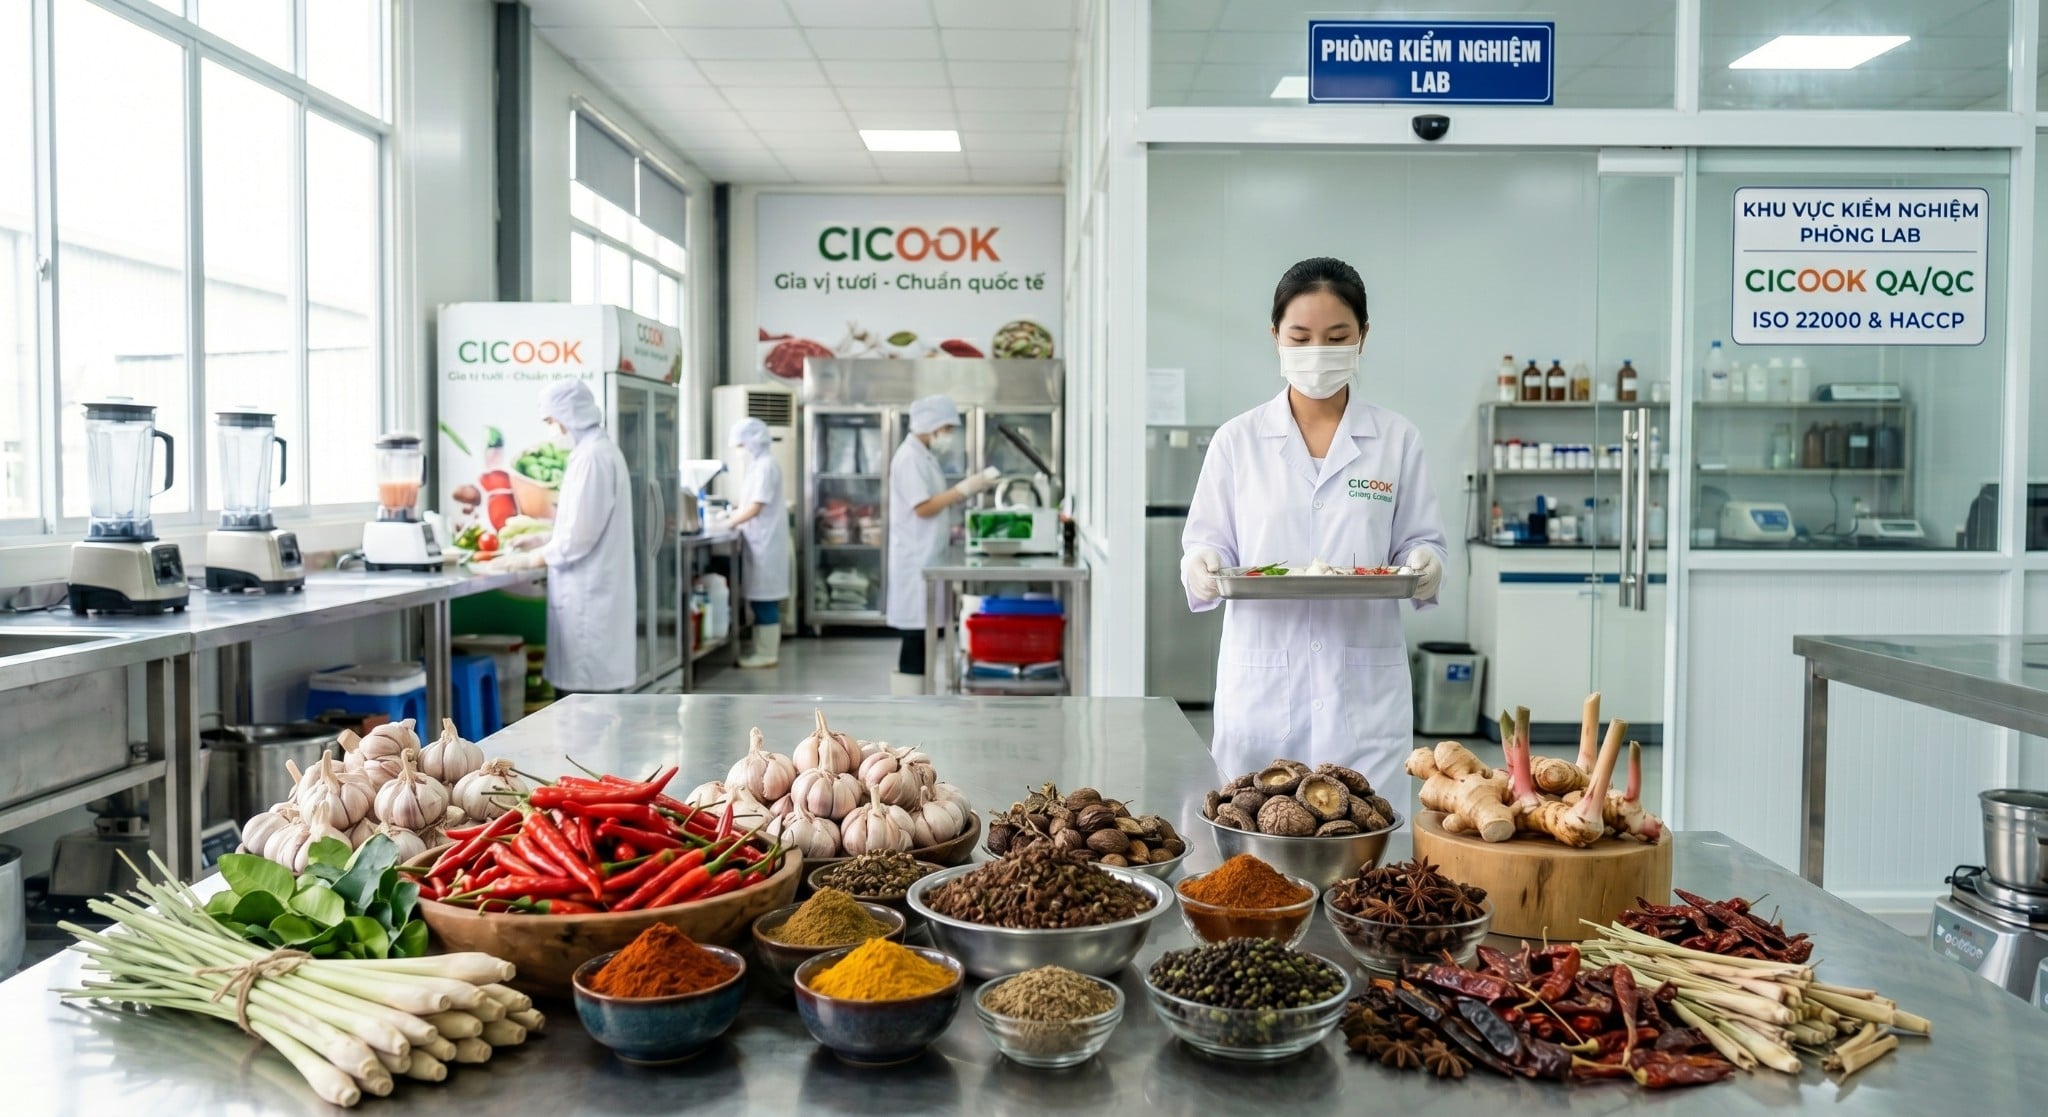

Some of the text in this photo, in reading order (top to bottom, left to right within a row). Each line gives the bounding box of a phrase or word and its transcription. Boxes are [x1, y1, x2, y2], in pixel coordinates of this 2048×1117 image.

[1321, 31, 1541, 67] PHÒNG KIỂM NGHIỆM
[1411, 71, 1450, 93] LAB
[1743, 202, 1786, 217] KHU
[1793, 200, 1835, 221] VỰC
[1899, 199, 1979, 221] NGHIỆM
[818, 226, 1001, 262] CICOOK
[1881, 228, 1921, 243] LAB
[774, 273, 807, 290] Gia
[813, 274, 830, 295] vị
[837, 274, 877, 290] tươi
[968, 271, 1019, 294] quốc
[1025, 272, 1045, 290] tế
[1745, 266, 1975, 296] CICOOK QA/QC
[1752, 311, 1965, 329] ISO 22000 & HACCP
[458, 340, 583, 364] CICOOK
[1348, 479, 1393, 493] CICOOK
